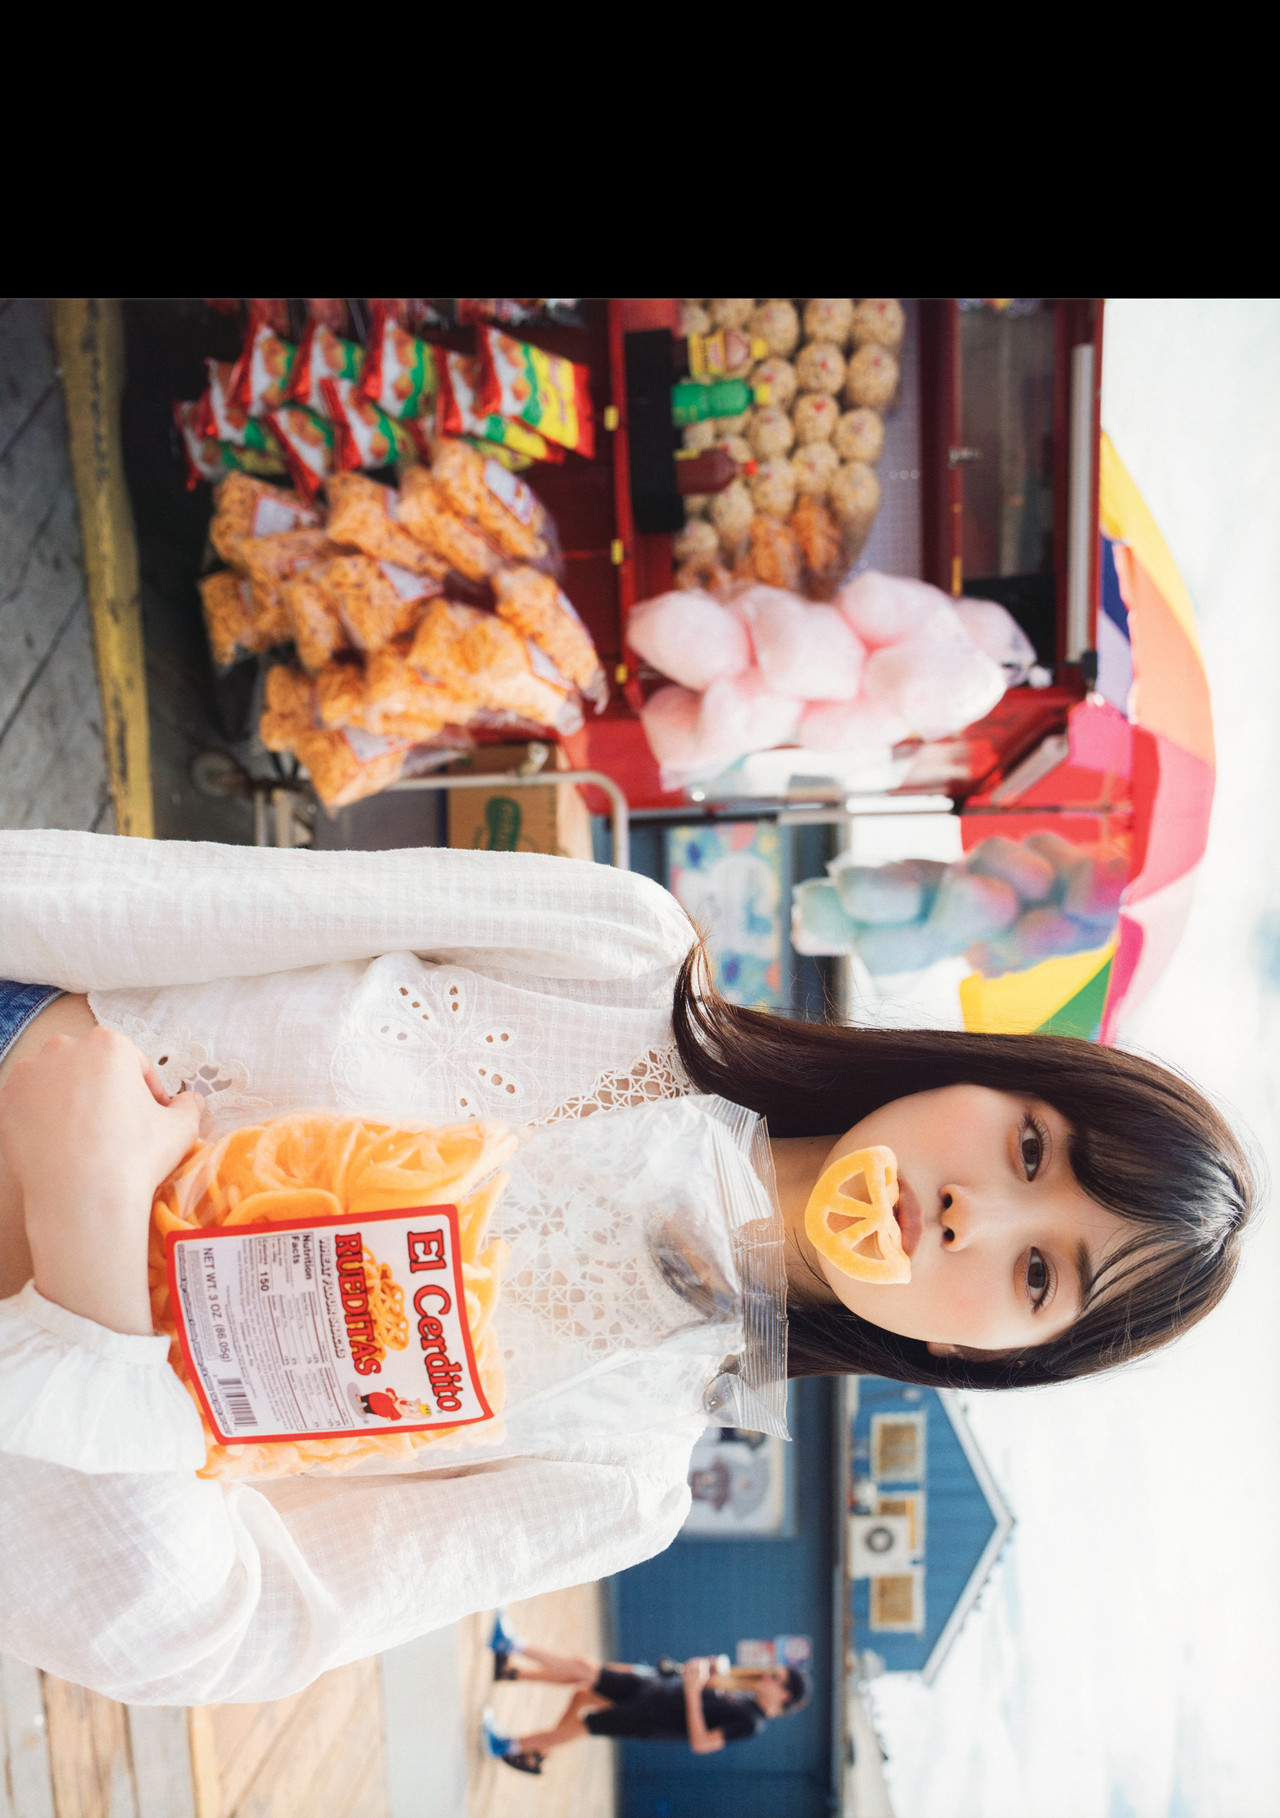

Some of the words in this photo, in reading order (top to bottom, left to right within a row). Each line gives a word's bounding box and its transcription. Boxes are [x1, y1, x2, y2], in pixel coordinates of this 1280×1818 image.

[203, 1248, 215, 1269] NET
[292, 1236, 300, 1264] Facts
[302, 1235, 314, 1280] Nutrition
[319, 1236, 333, 1277] WHEAT
[407, 1228, 447, 1274] El
[206, 1272, 217, 1292] WT.
[260, 1272, 270, 1292] 150
[322, 1279, 337, 1316] FLOUR
[211, 1304, 222, 1321] OZ.
[335, 1232, 382, 1376] RUEDITAS
[213, 1324, 232, 1363] (86.05g)
[329, 1318, 346, 1359] SNACKS
[413, 1284, 463, 1412] Cerdito
